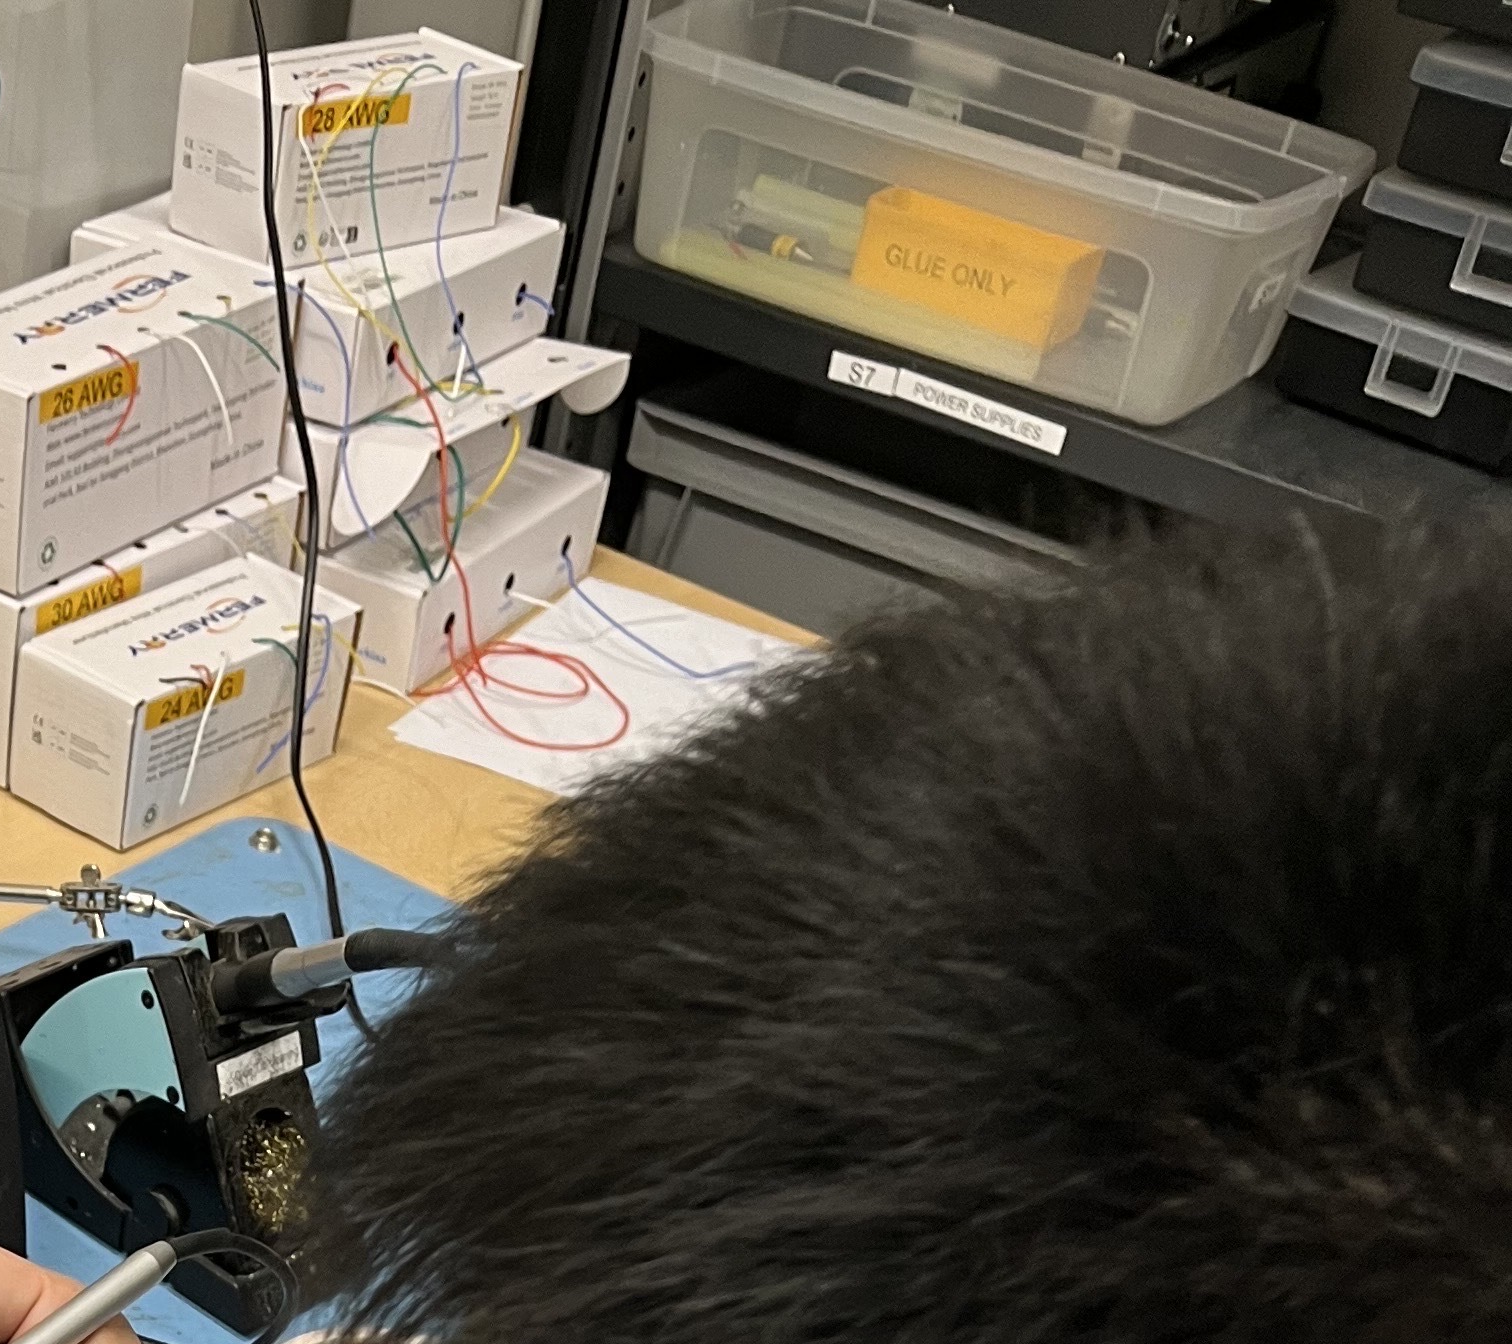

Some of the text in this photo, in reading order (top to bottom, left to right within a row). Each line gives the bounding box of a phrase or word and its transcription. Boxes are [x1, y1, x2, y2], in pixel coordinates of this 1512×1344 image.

[312, 100, 390, 133] 28 AWG
[885, 243, 1017, 298] GLUE ONLY
[52, 371, 124, 417] 26 AWG
[848, 361, 876, 388] S7
[913, 381, 1043, 442] POWER SUPPLIES
[51, 598, 73, 626] 30
[76, 578, 124, 617] AWG
[160, 676, 234, 723] 24 AG
